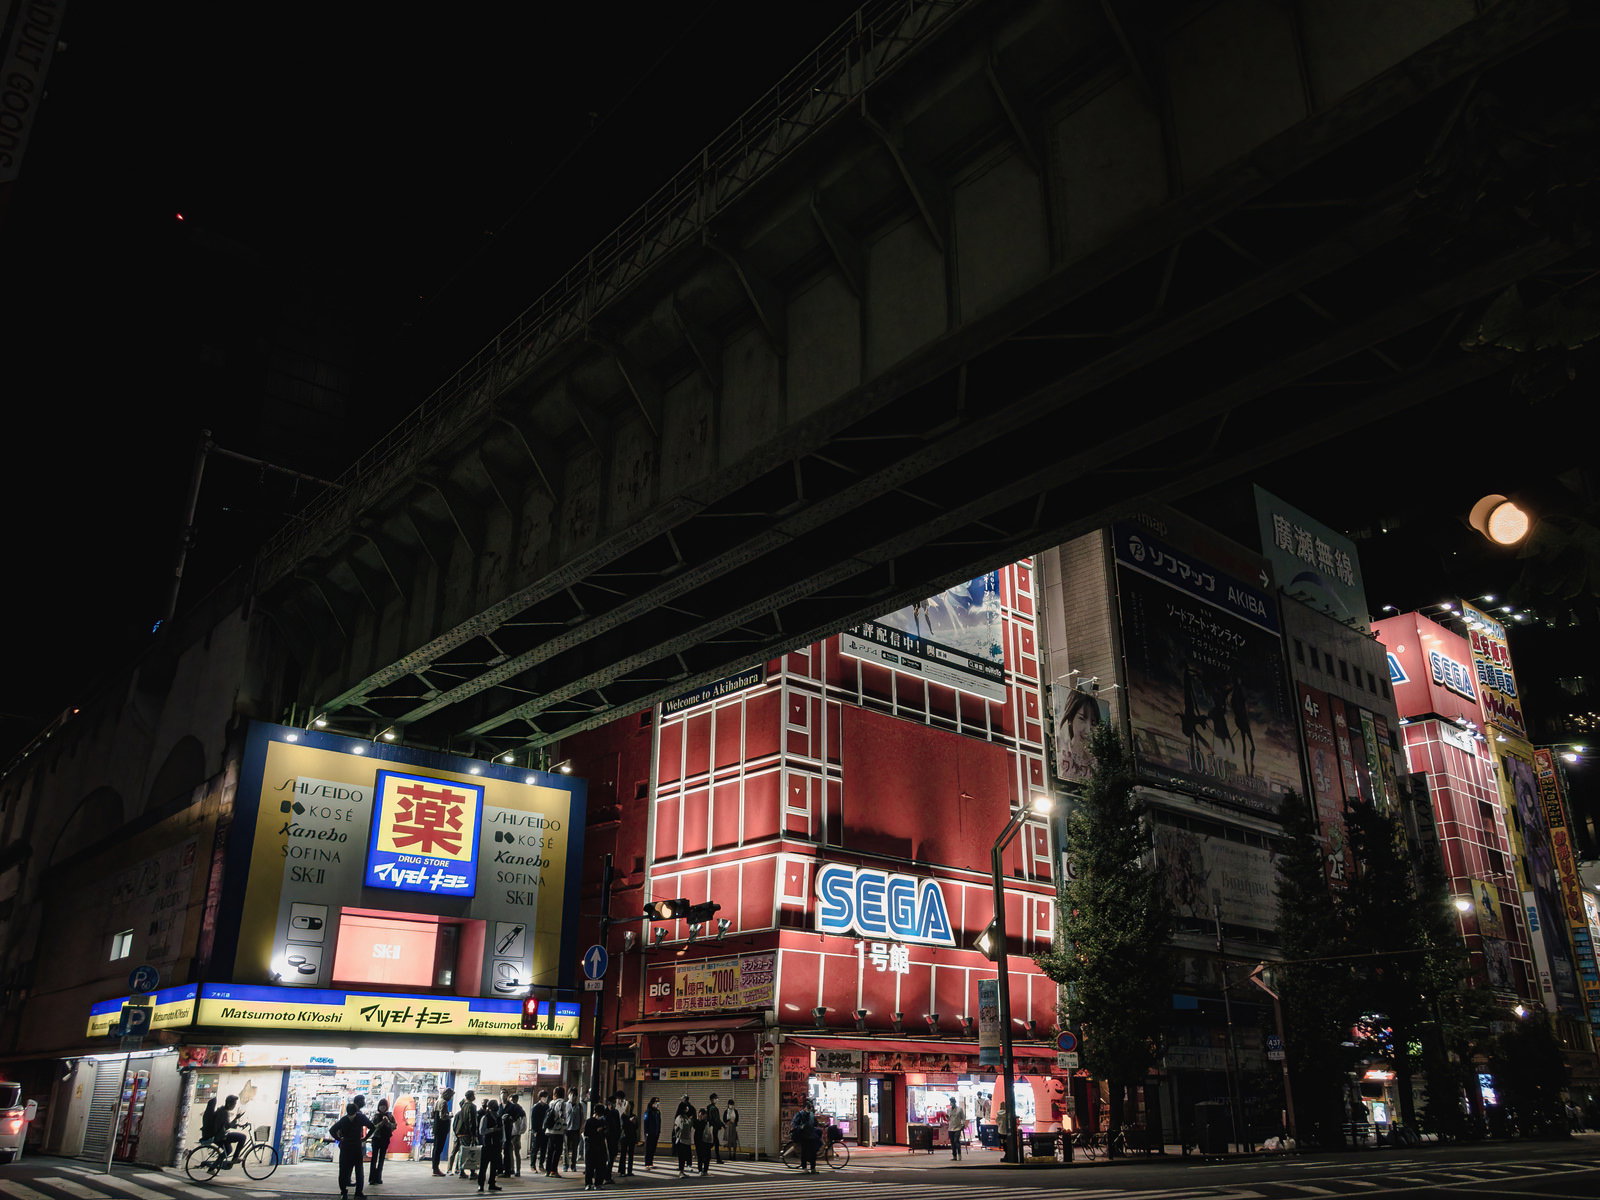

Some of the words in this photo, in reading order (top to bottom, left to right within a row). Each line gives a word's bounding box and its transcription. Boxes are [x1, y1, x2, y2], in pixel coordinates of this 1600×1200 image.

[1149, 545, 1216, 592] ソフマップ
[1228, 586, 1267, 619] AKIBA
[1429, 649, 1476, 702] SEGA
[666, 693, 698, 714] Welcome
[701, 690, 711, 702] to
[712, 672, 759, 699] Akihabara
[274, 778, 363, 802] SHISEIDO
[309, 804, 353, 822] KOSÉ
[392, 783, 466, 856] 薬
[488, 811, 561, 831] SHISEIDO
[279, 822, 348, 843] Kanebo
[518, 834, 555, 849] KOSÉ
[281, 844, 341, 863] SOFINA
[398, 854, 422, 866] DRUG
[424, 857, 451, 869] STORE
[494, 850, 551, 869] Kanebo
[373, 866, 470, 891] マツモトキヨシ
[497, 871, 547, 887] SOFINA
[818, 864, 954, 944] SEGA
[854, 942, 910, 975] 1号館
[134, 971, 147, 988] P
[127, 1009, 146, 1033] P
[221, 1008, 296, 1021] Matsumoto
[297, 1011, 344, 1023] KiYoshi
[360, 1004, 453, 1028] マツモトキヨシ
[468, 1018, 523, 1030] Matsumot
[682, 1035, 719, 1056] 宝くじ
